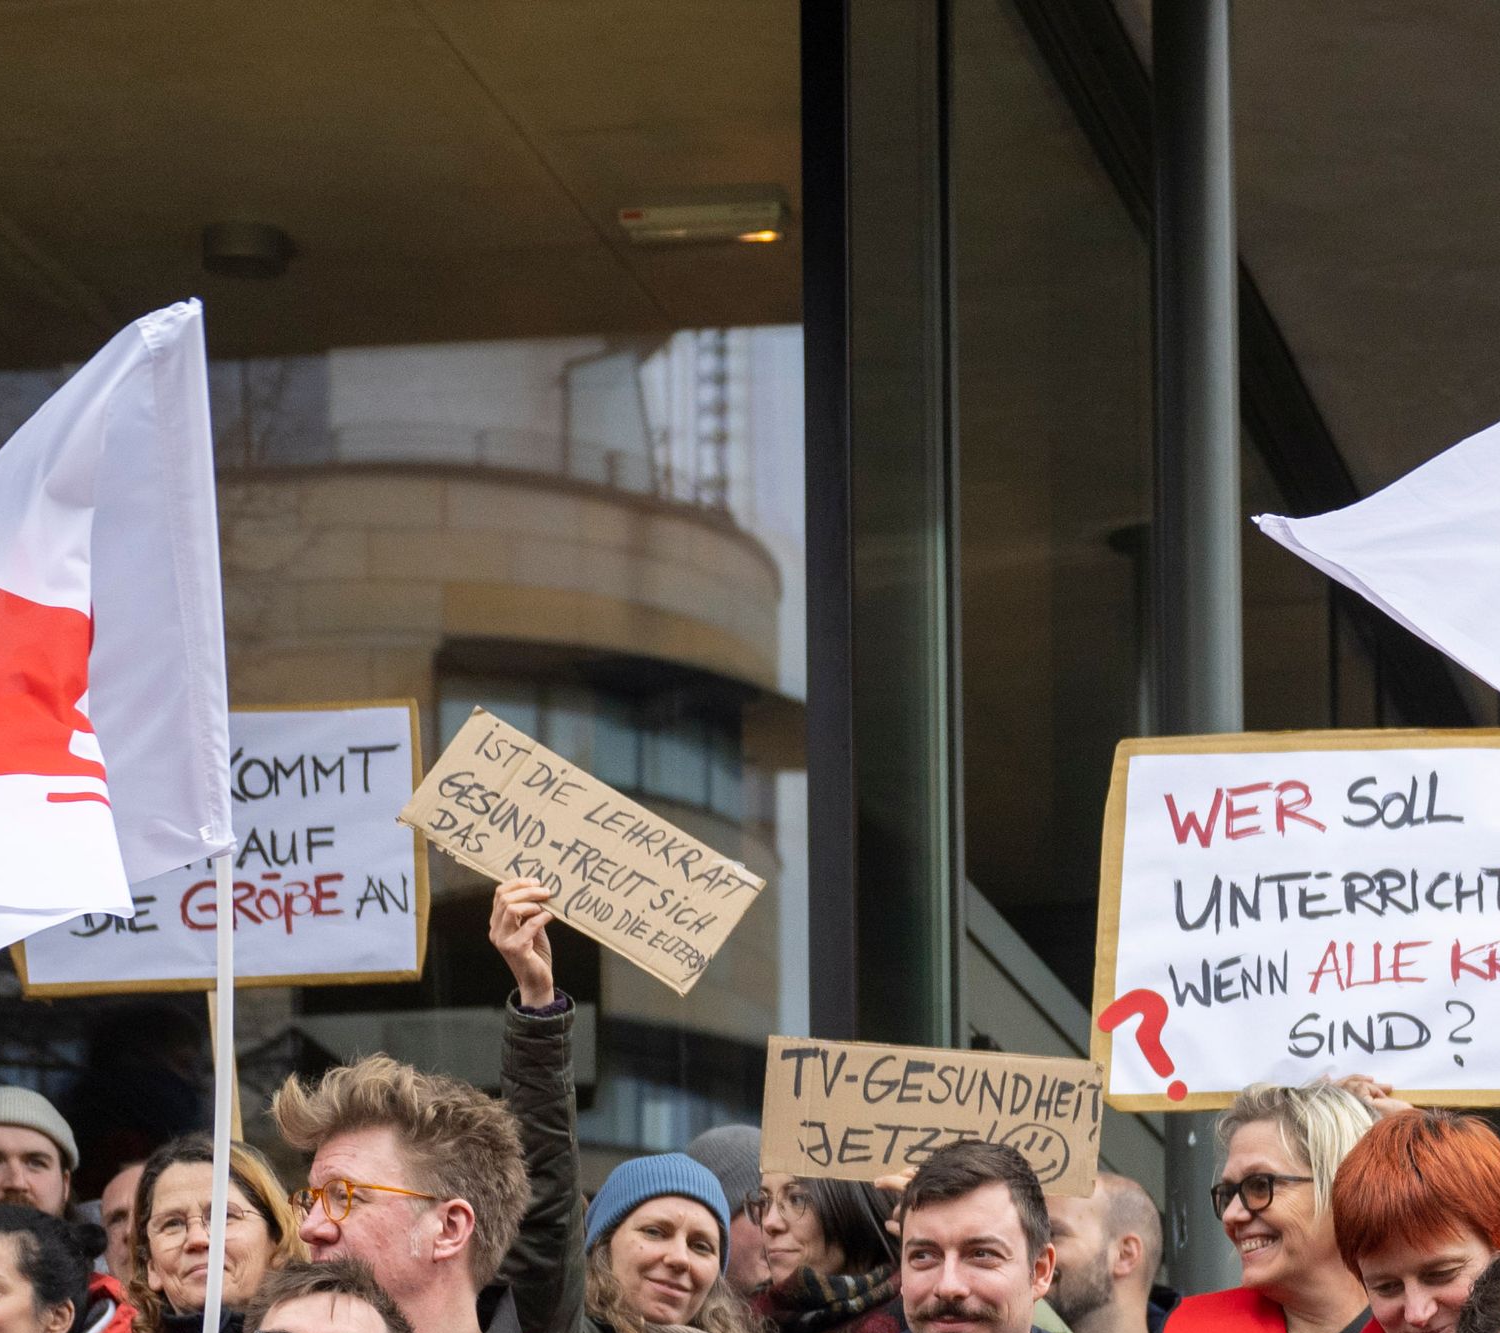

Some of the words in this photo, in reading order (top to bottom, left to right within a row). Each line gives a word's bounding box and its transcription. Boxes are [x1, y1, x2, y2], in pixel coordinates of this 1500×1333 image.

[235, 826, 335, 870] AUF
[428, 808, 491, 854] DAS
[1163, 779, 1327, 849] WER
[583, 801, 761, 900] LEHRKRAFT
[1167, 949, 1289, 1008] WENN
[1308, 939, 1433, 995] ALLE
